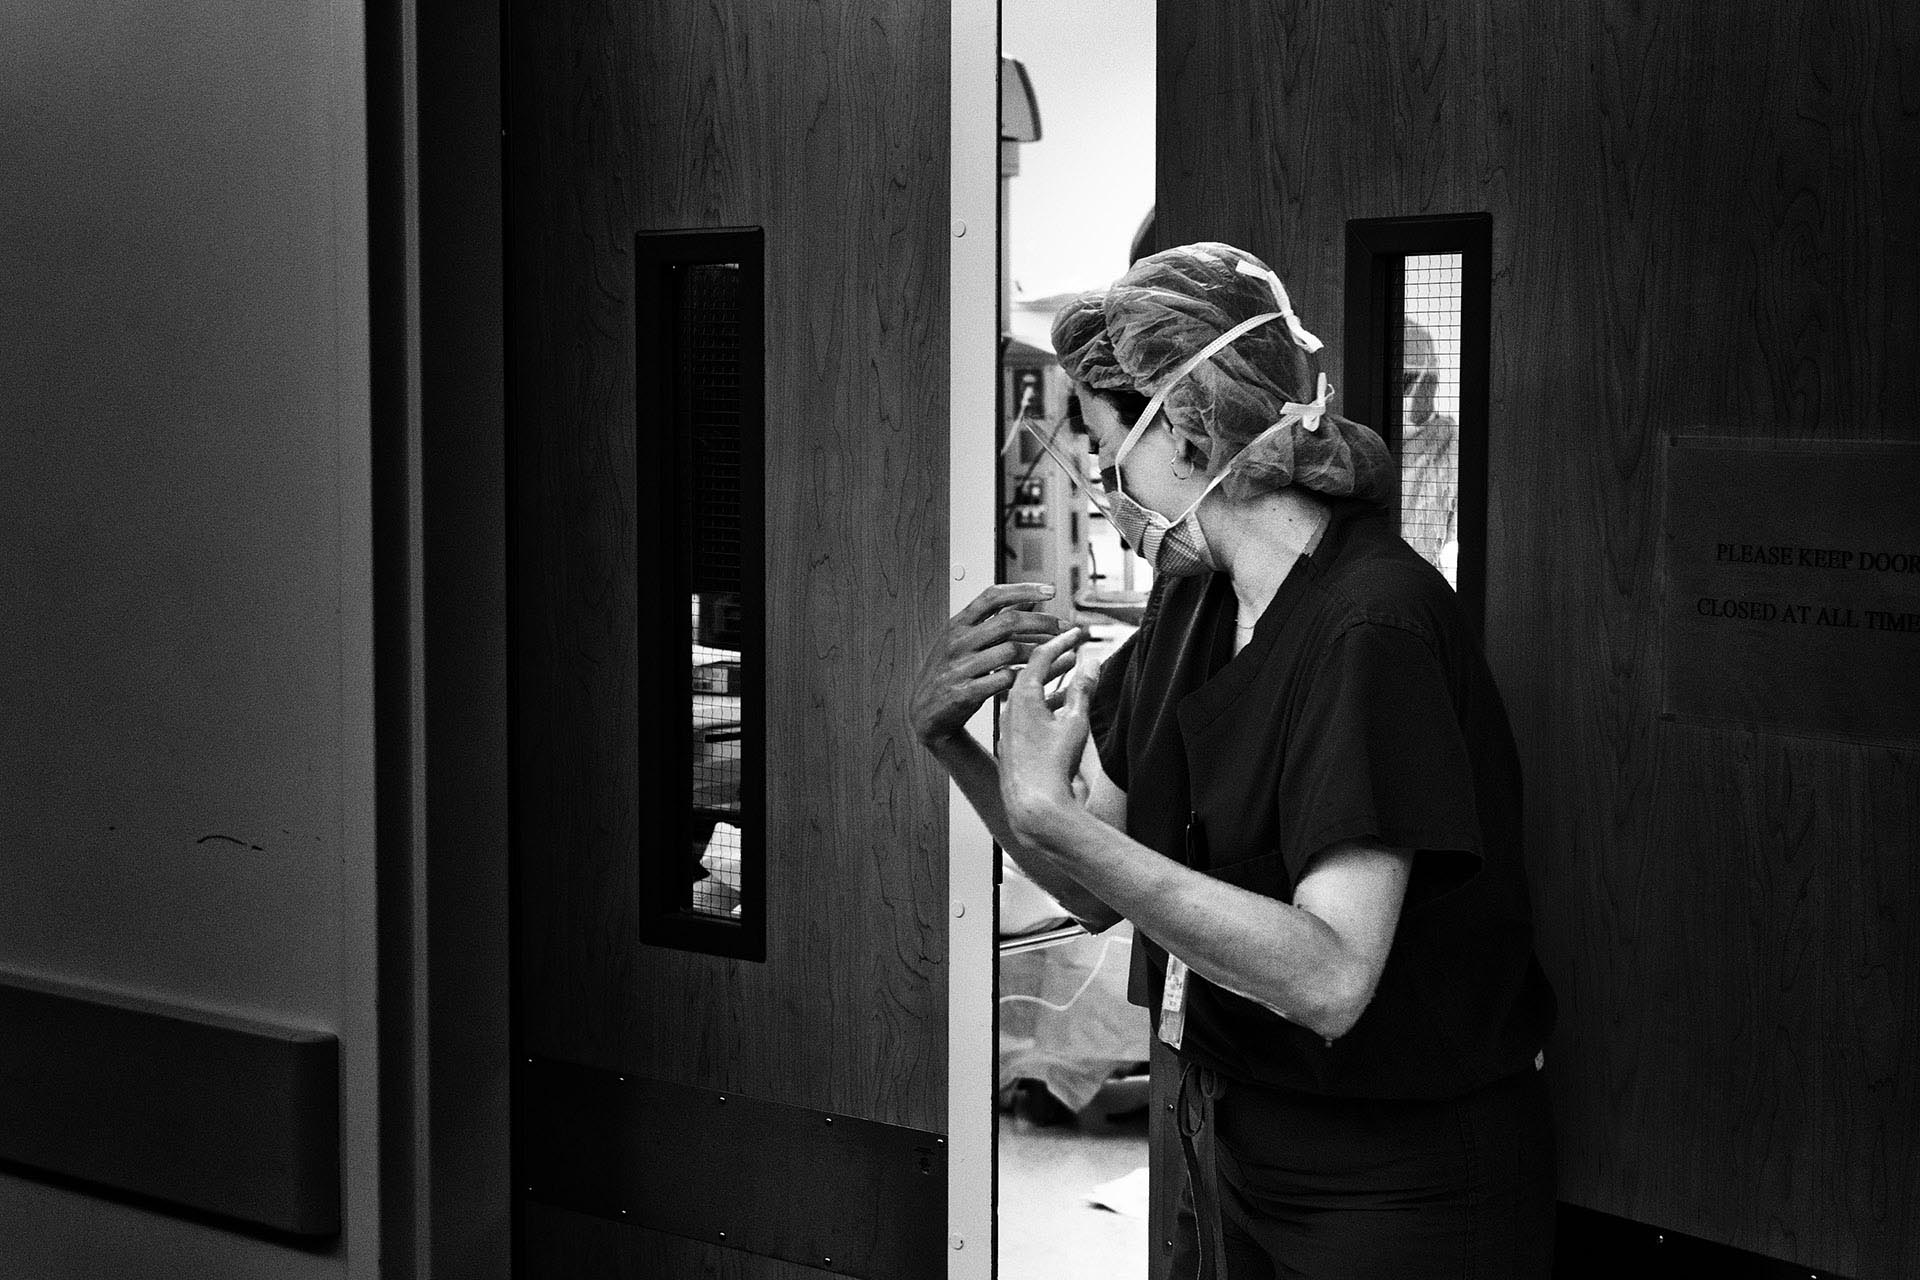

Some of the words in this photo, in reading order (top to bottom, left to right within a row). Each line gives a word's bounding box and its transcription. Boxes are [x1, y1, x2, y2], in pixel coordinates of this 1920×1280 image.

[1717, 544, 1793, 566] PLEASE
[1800, 548, 1853, 569] KEEP
[1697, 598, 1777, 621] CLOSED
[1781, 604, 1811, 624] AT
[1816, 607, 1859, 628] ALL
